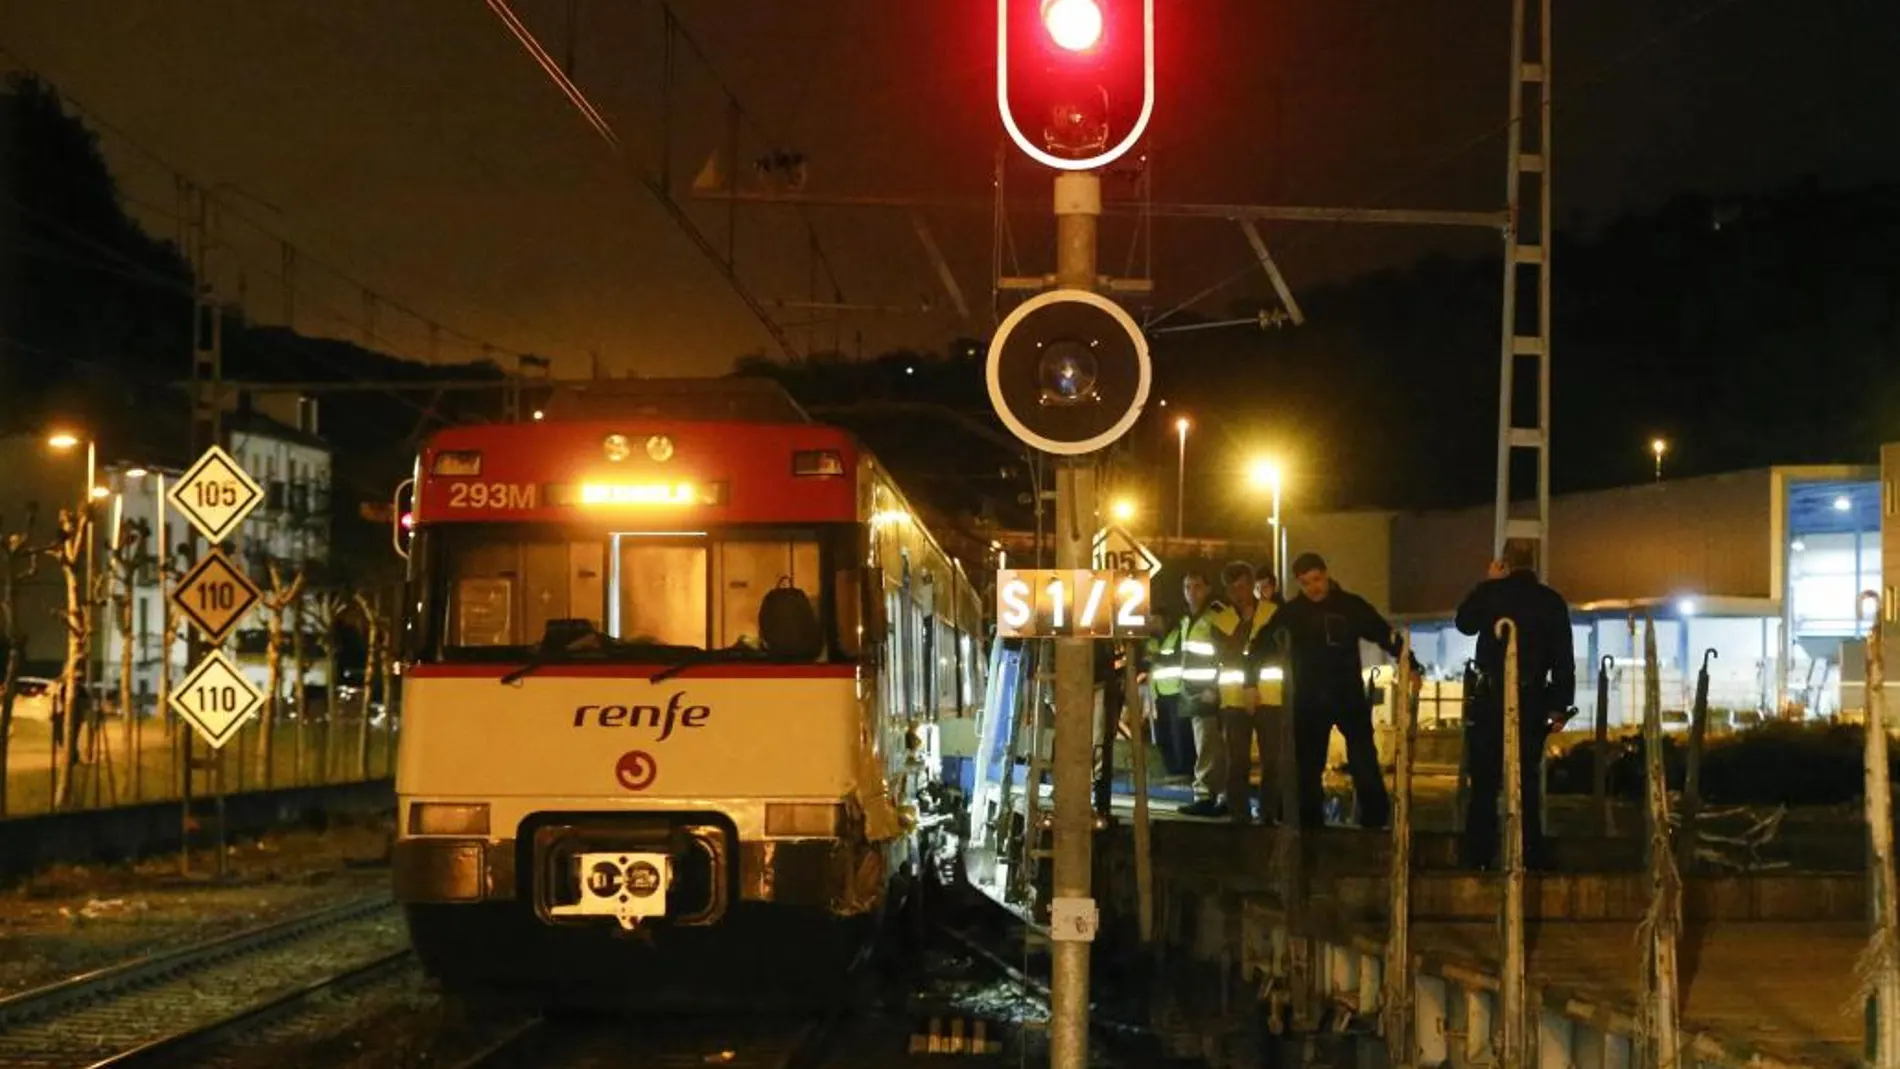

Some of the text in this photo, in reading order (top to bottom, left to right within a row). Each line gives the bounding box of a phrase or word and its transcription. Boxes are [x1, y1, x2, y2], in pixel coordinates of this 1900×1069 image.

[195, 481, 237, 508] 105
[450, 483, 536, 509] 293M
[196, 581, 235, 611] 110
[196, 686, 236, 713] 110
[573, 691, 711, 742] renfe
